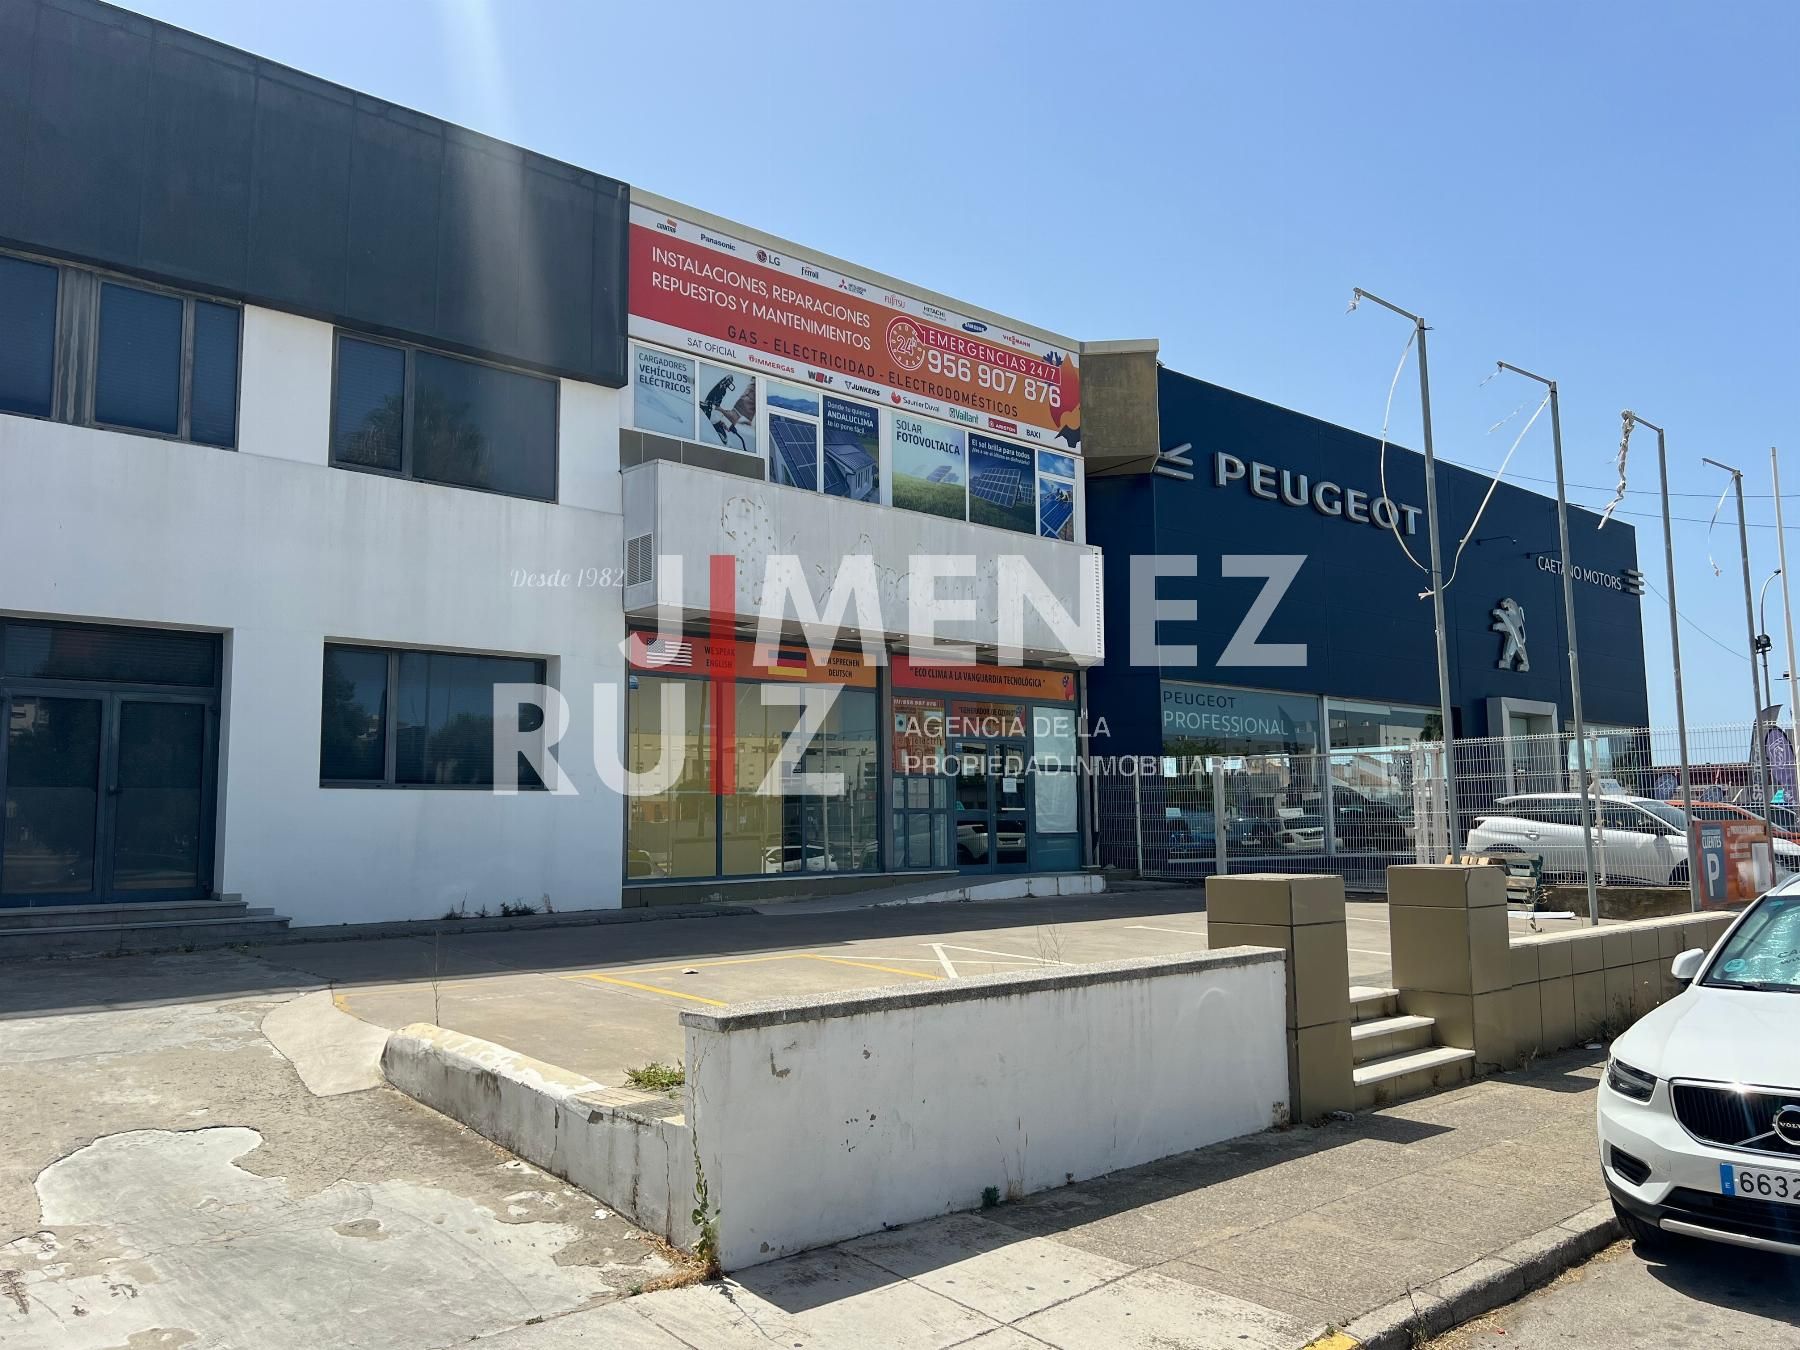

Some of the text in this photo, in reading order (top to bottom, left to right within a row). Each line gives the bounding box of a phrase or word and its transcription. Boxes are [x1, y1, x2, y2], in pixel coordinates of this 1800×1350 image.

[700, 233, 736, 251] Panasonic
[768, 254, 781, 266] LG
[652, 246, 870, 328] INSTALACIONES, REPARACIONES
[652, 272, 871, 350] REPUESTOS Y MANTENIMIENTOS
[884, 294, 906, 309] FUJITSU
[687, 337, 736, 359] SAT OFICIAL
[929, 330, 1056, 380] EMERGENCIAS 24/7
[638, 352, 687, 372] CARGADORES
[728, 325, 757, 345] GAS
[774, 339, 875, 378] ELECTRICIDAD
[888, 372, 1018, 417] ELECTRODOMÉSTICOS
[755, 356, 795, 373] IMMERGAS
[639, 363, 688, 384] VEHÍCULOS
[927, 350, 1061, 407] 956 907 876
[639, 374, 691, 395] ELÉCTRICOS
[850, 382, 881, 397] JUNKERS
[827, 401, 844, 411] Donde
[851, 408, 871, 418] quieras
[827, 410, 874, 428] ANDALUCLIMA
[955, 409, 979, 424] Vaillant
[840, 423, 854, 431] pone
[896, 419, 922, 435] SOLAR
[1026, 428, 1041, 439] BAXI
[896, 430, 961, 456] FOTOVOLTAICA
[971, 439, 1030, 460] El sol brilla para todos
[1215, 451, 1422, 535] PEUGEOT
[1584, 568, 1622, 590] MOTORS
[704, 646, 736, 657] WE SPEAK
[706, 657, 733, 668] ENGLISH
[832, 657, 860, 668] SPRECHEN
[828, 669, 853, 678] DEUTSCH
[914, 667, 927, 677] ECO
[928, 668, 947, 679] CLIMA
[948, 671, 953, 680] A
[954, 672, 962, 680] LA
[963, 672, 1003, 684] VANGUARDIA
[1003, 674, 1042, 688] TECNOLÓGICA
[1163, 690, 1237, 709] PEUGEOT
[1163, 710, 1289, 736] PROFESSIONAL
[1702, 836, 1722, 849] CLIENTES
[1707, 853, 1720, 897] P
